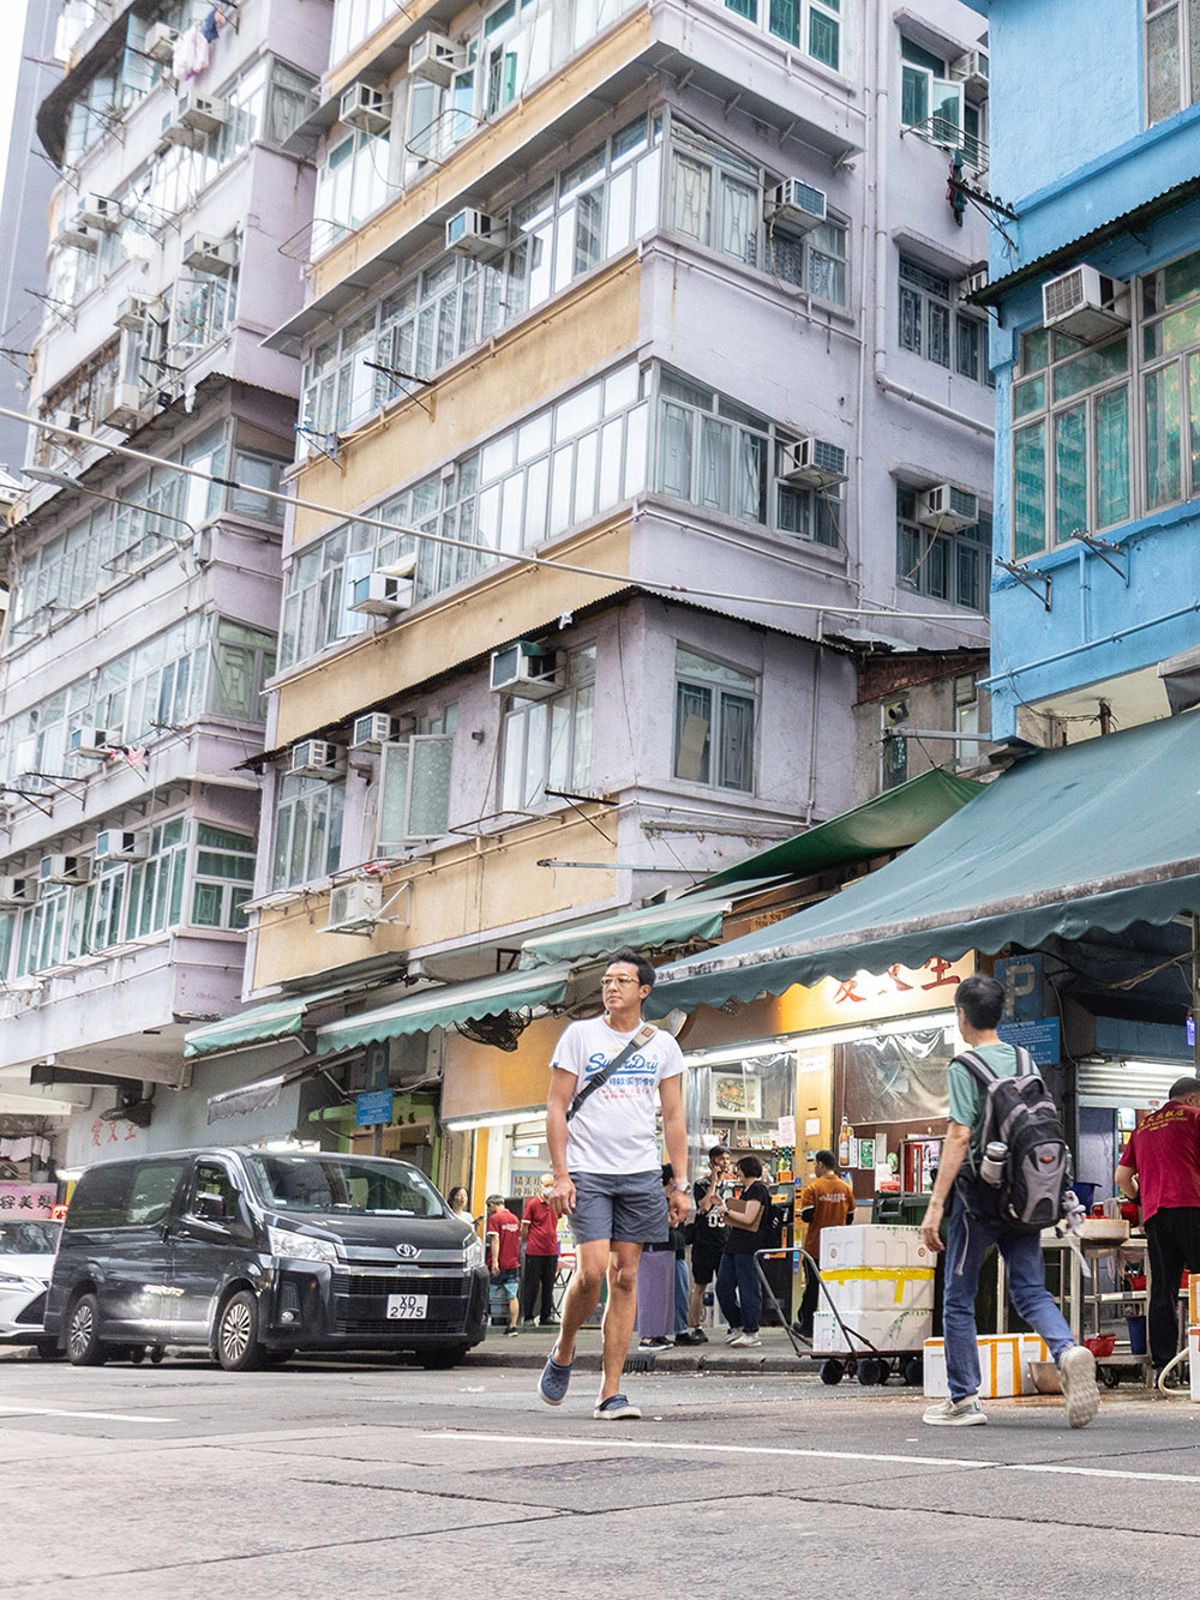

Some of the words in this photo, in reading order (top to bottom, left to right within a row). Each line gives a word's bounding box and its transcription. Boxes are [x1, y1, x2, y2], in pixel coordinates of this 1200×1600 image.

[1005, 963, 1035, 1017] P
[371, 1050, 385, 1088] P
[390, 1306, 424, 1318] 2775
[400, 1295, 417, 1307] XD
